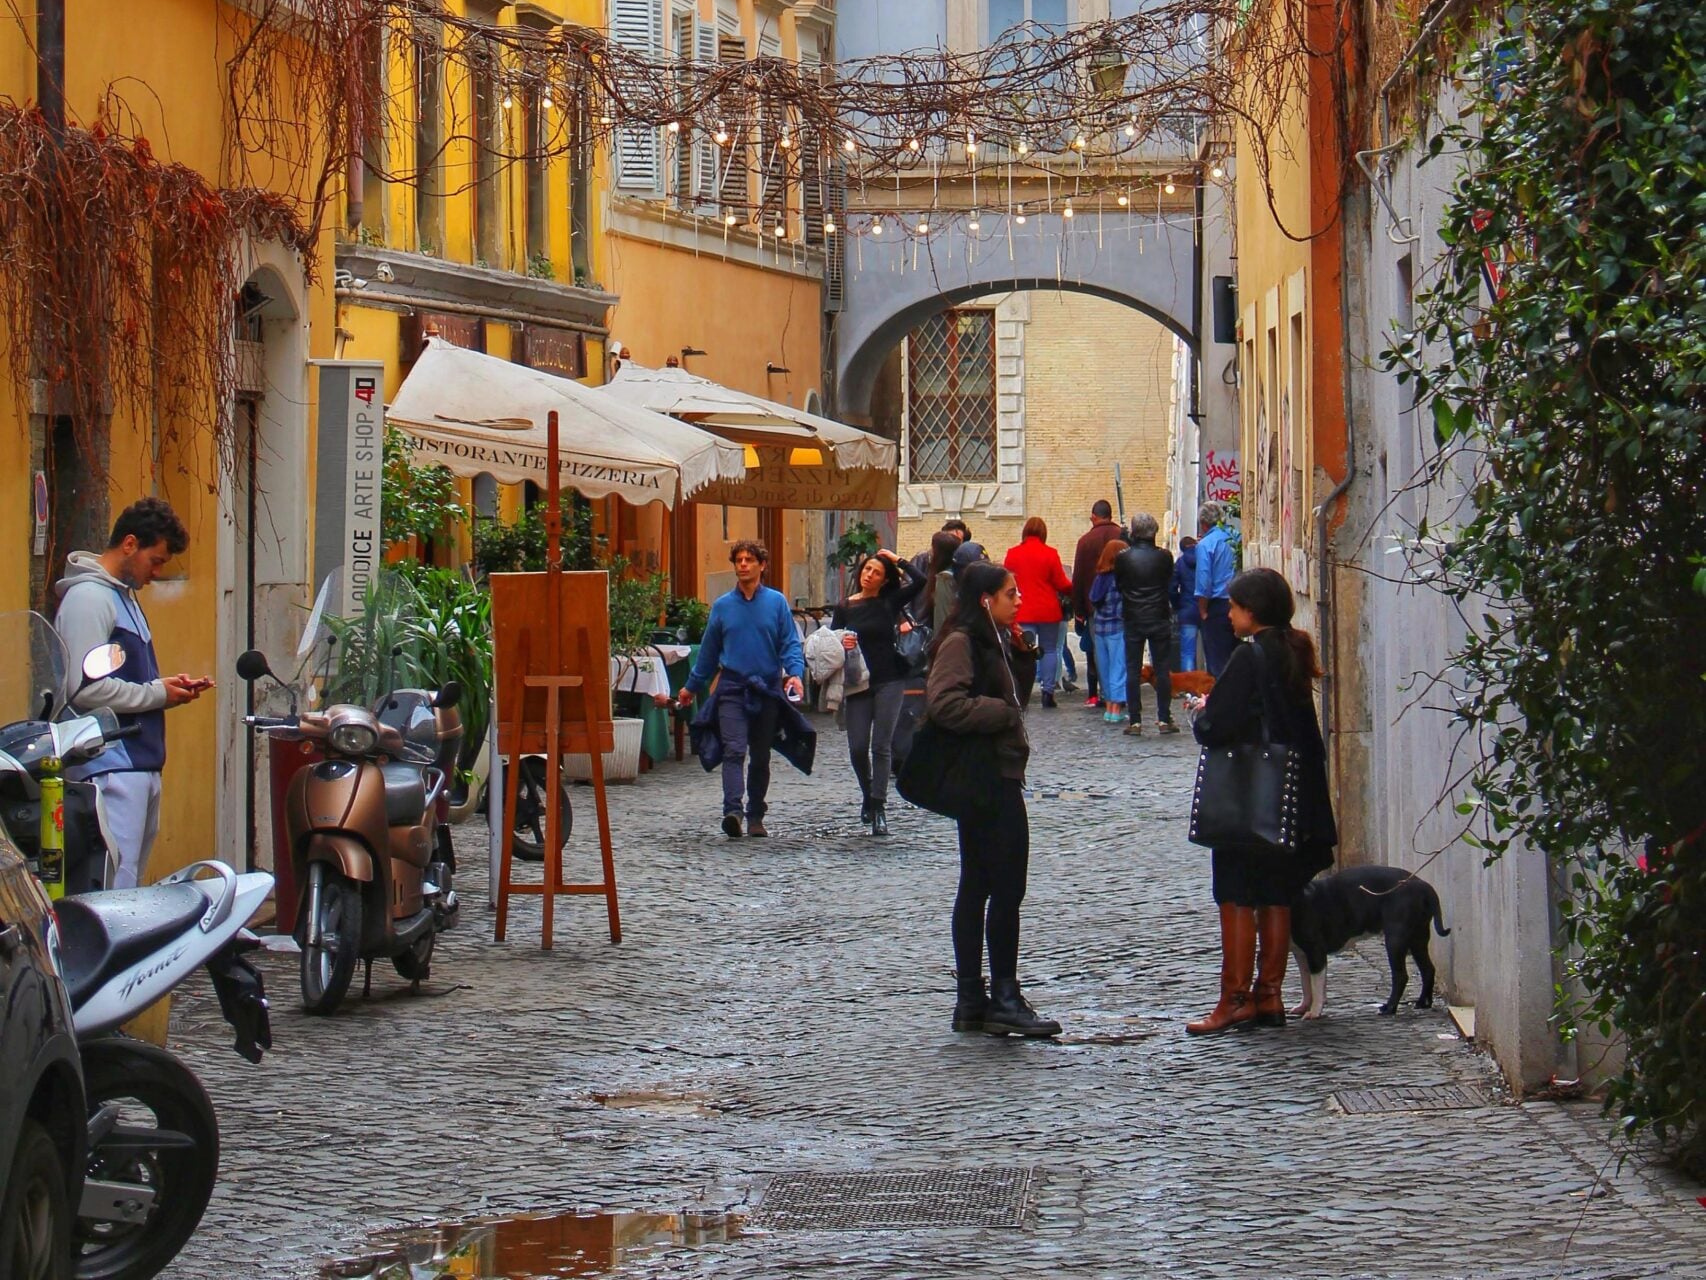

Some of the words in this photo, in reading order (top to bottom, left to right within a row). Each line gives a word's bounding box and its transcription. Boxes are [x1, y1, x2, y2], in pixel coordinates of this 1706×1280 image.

[355, 412, 374, 461] SHOP
[354, 470, 374, 519] ARTE
[558, 459, 660, 490] PIZZERIA
[117, 939, 191, 1001] Hornet
